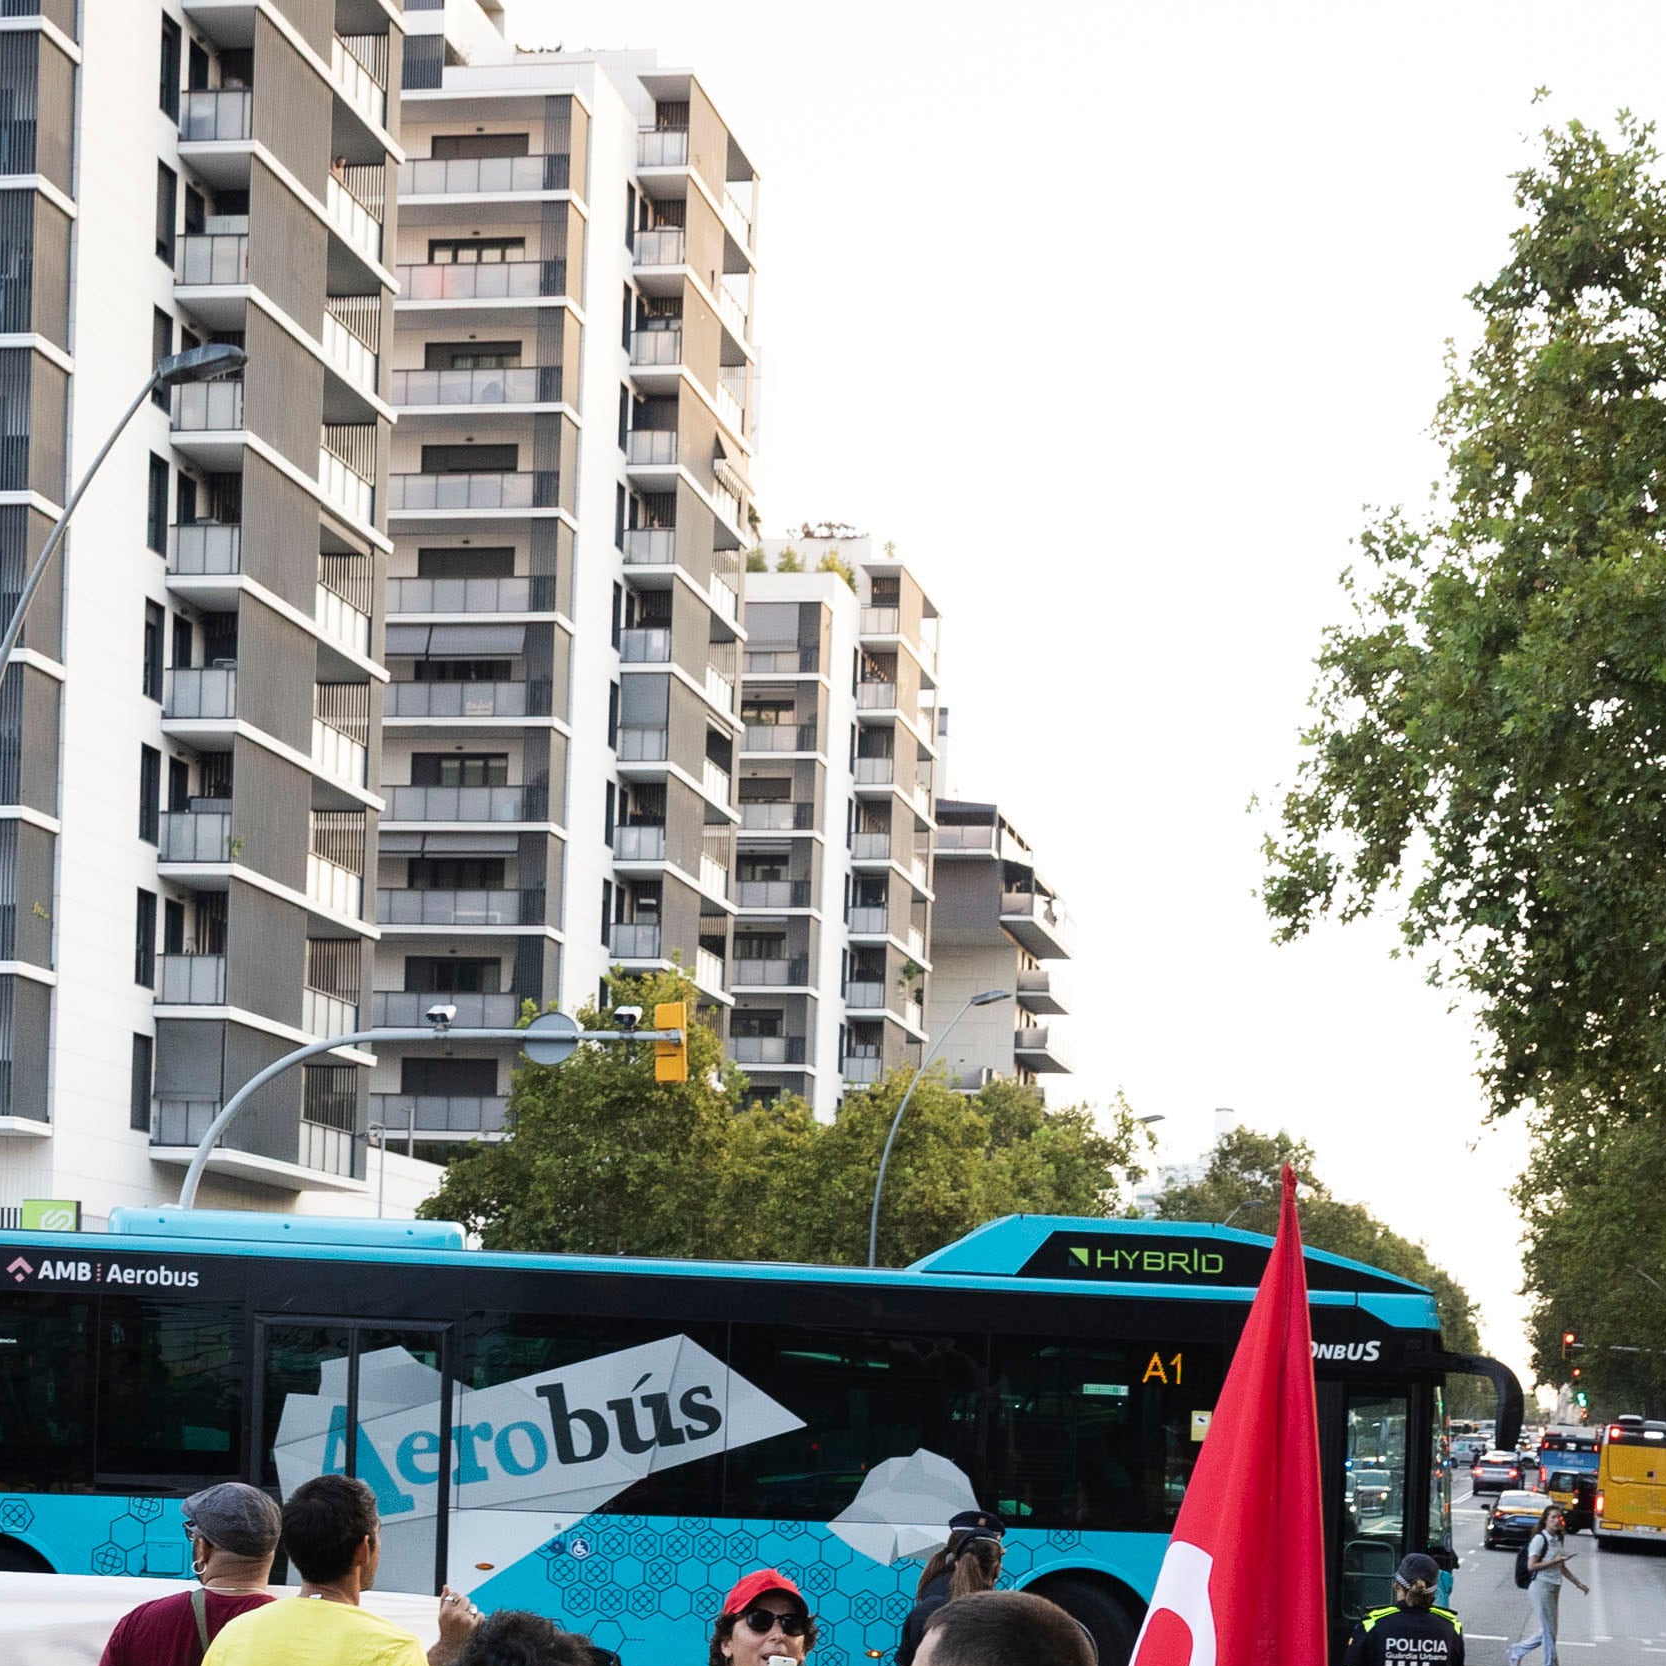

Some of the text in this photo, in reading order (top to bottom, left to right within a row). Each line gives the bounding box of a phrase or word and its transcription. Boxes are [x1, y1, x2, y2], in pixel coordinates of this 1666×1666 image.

[37, 1260, 199, 1288] AMB Aerobus
[1096, 1248, 1224, 1274] HYBRID
[1141, 1352, 1182, 1384] A1
[321, 1373, 723, 1517] Aerobús
[1386, 1638, 1448, 1653] POLICIA
